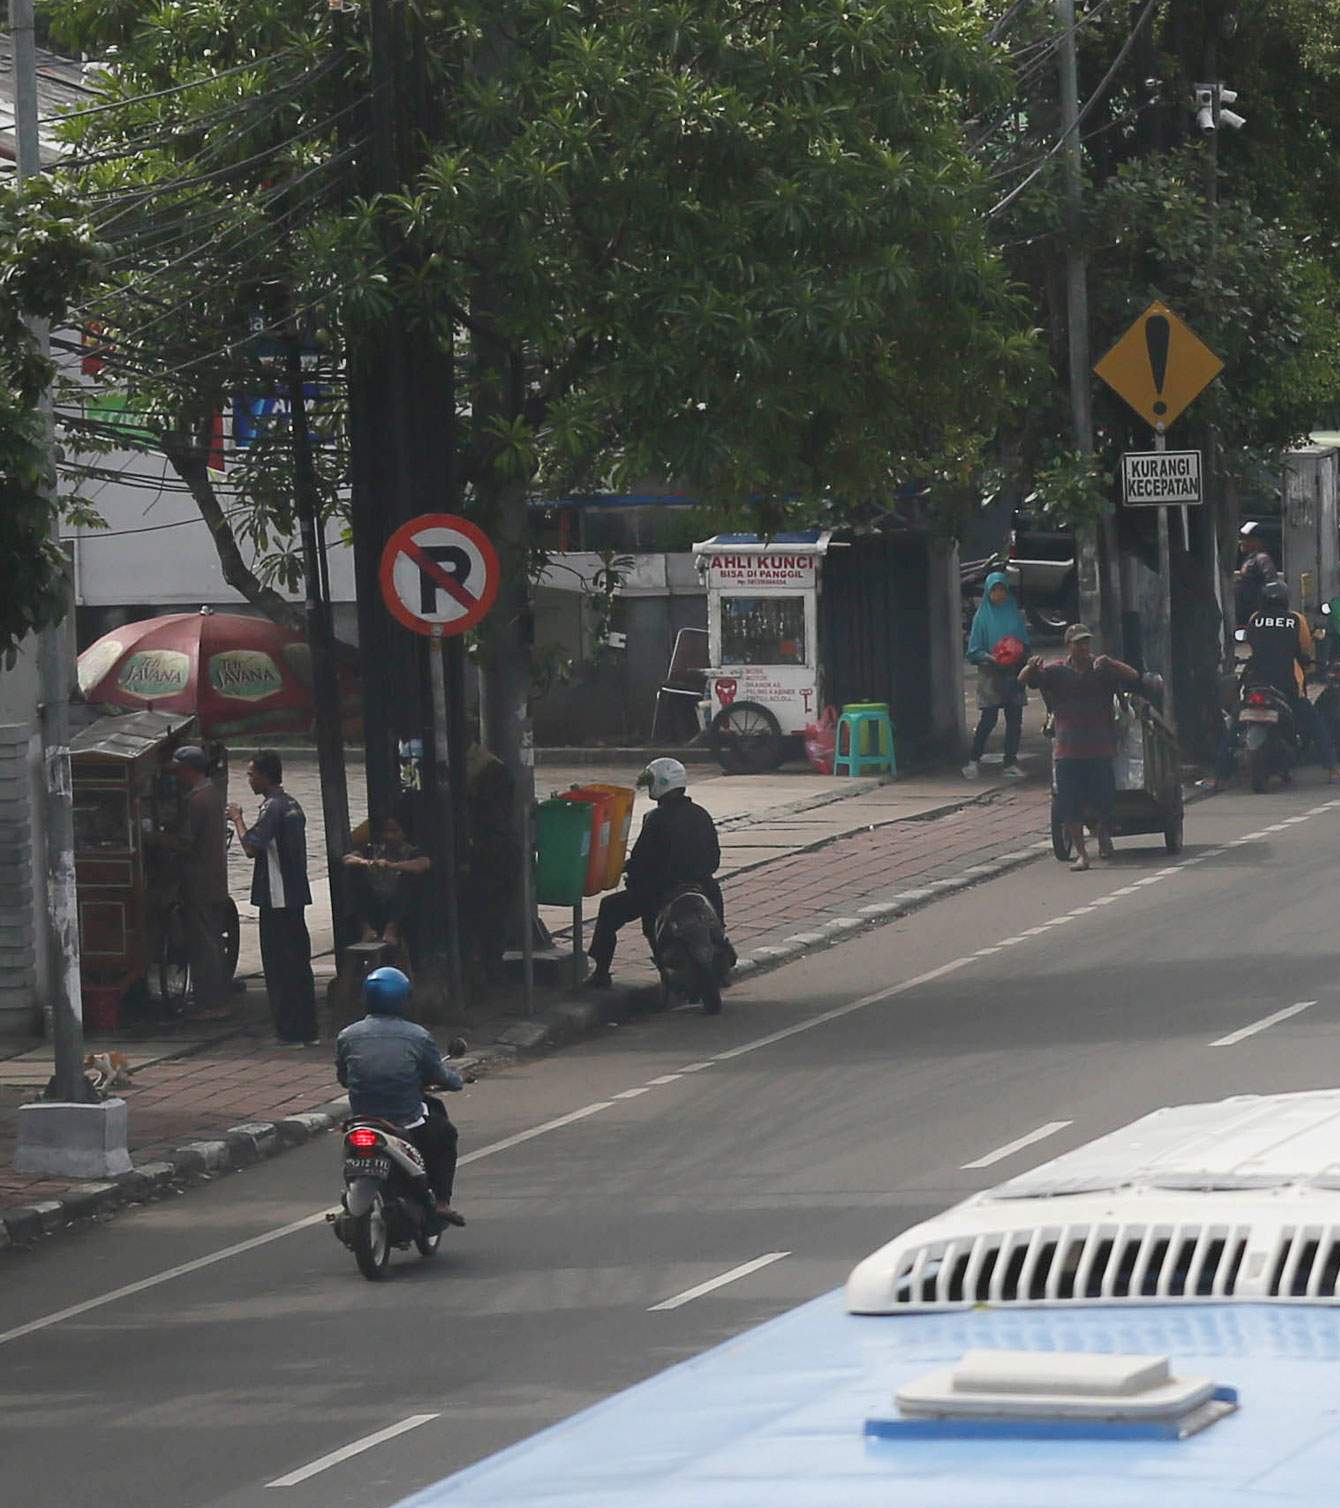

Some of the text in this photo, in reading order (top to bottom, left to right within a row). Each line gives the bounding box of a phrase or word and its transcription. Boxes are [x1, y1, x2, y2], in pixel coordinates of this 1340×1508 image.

[1131, 459, 1190, 477] KURANGI
[1128, 478, 1199, 498] KECEPATAN
[711, 556, 814, 569] AHLI KUNCI
[720, 570, 804, 578] BISA DI PANGGIL
[1254, 617, 1296, 629] UBER
[126, 665, 183, 685] JAVANA
[218, 668, 276, 689] JAVANA
